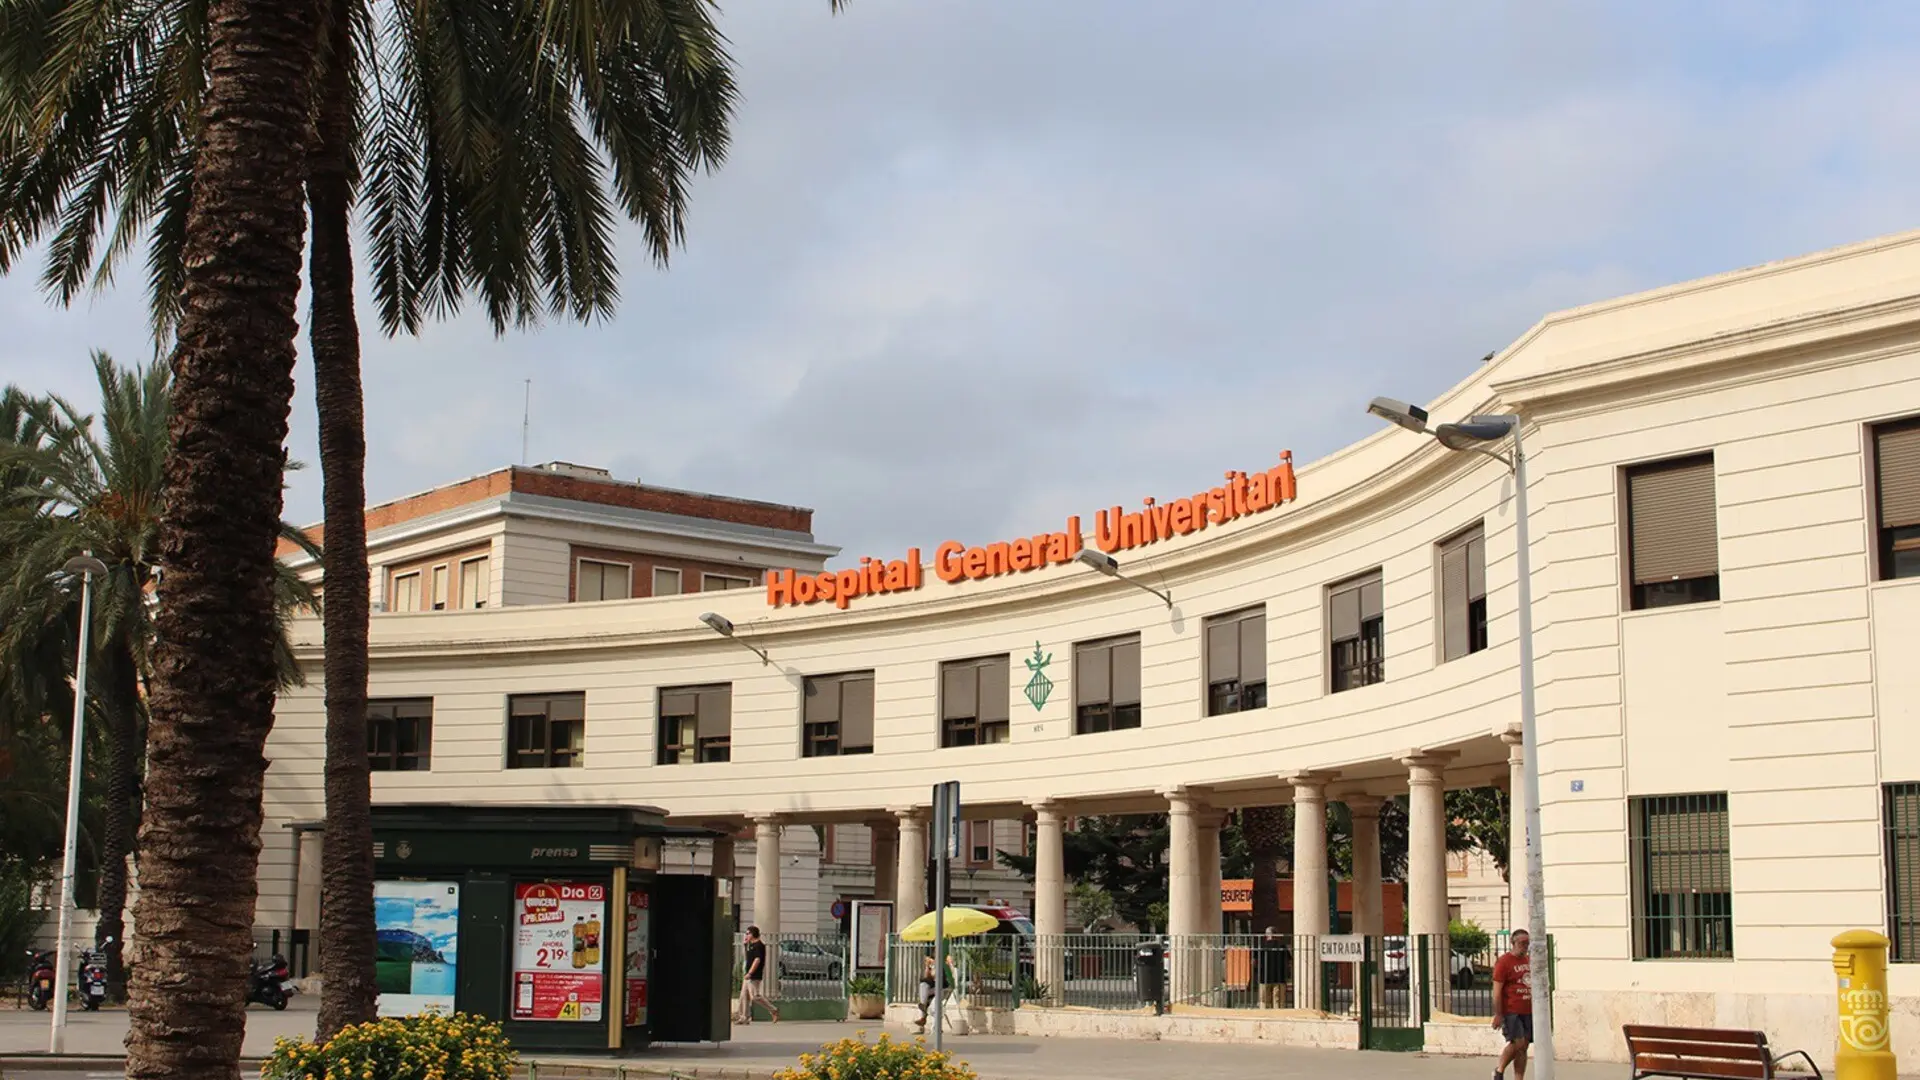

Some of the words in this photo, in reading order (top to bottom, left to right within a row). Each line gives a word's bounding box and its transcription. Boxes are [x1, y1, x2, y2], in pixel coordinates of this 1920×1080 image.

[767, 548, 921, 611] Hospital
[934, 515, 1082, 584] General
[531, 847, 578, 859] prensa
[1221, 889, 1253, 902] EGURETA
[1321, 941, 1362, 955] ENTRADA
